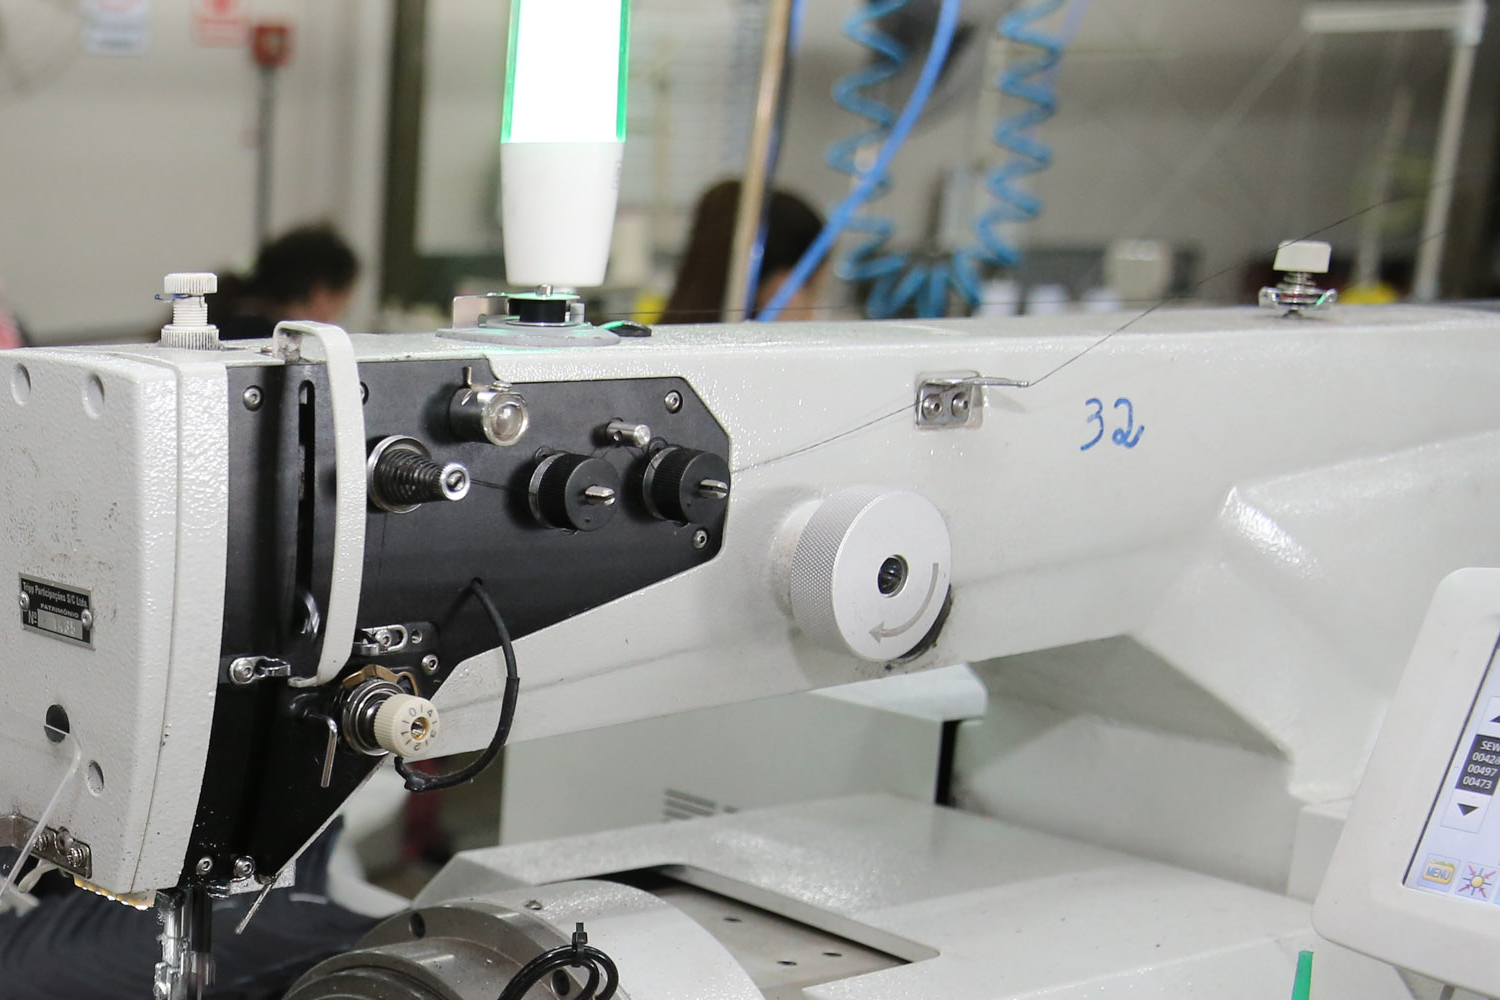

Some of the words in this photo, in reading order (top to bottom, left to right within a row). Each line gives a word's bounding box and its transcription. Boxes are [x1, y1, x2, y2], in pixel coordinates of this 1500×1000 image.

[1080, 397, 1145, 451] 32
[1467, 764, 1498, 777] 00497
[1462, 776, 1493, 790] 00473
[1426, 867, 1451, 881] MENU
